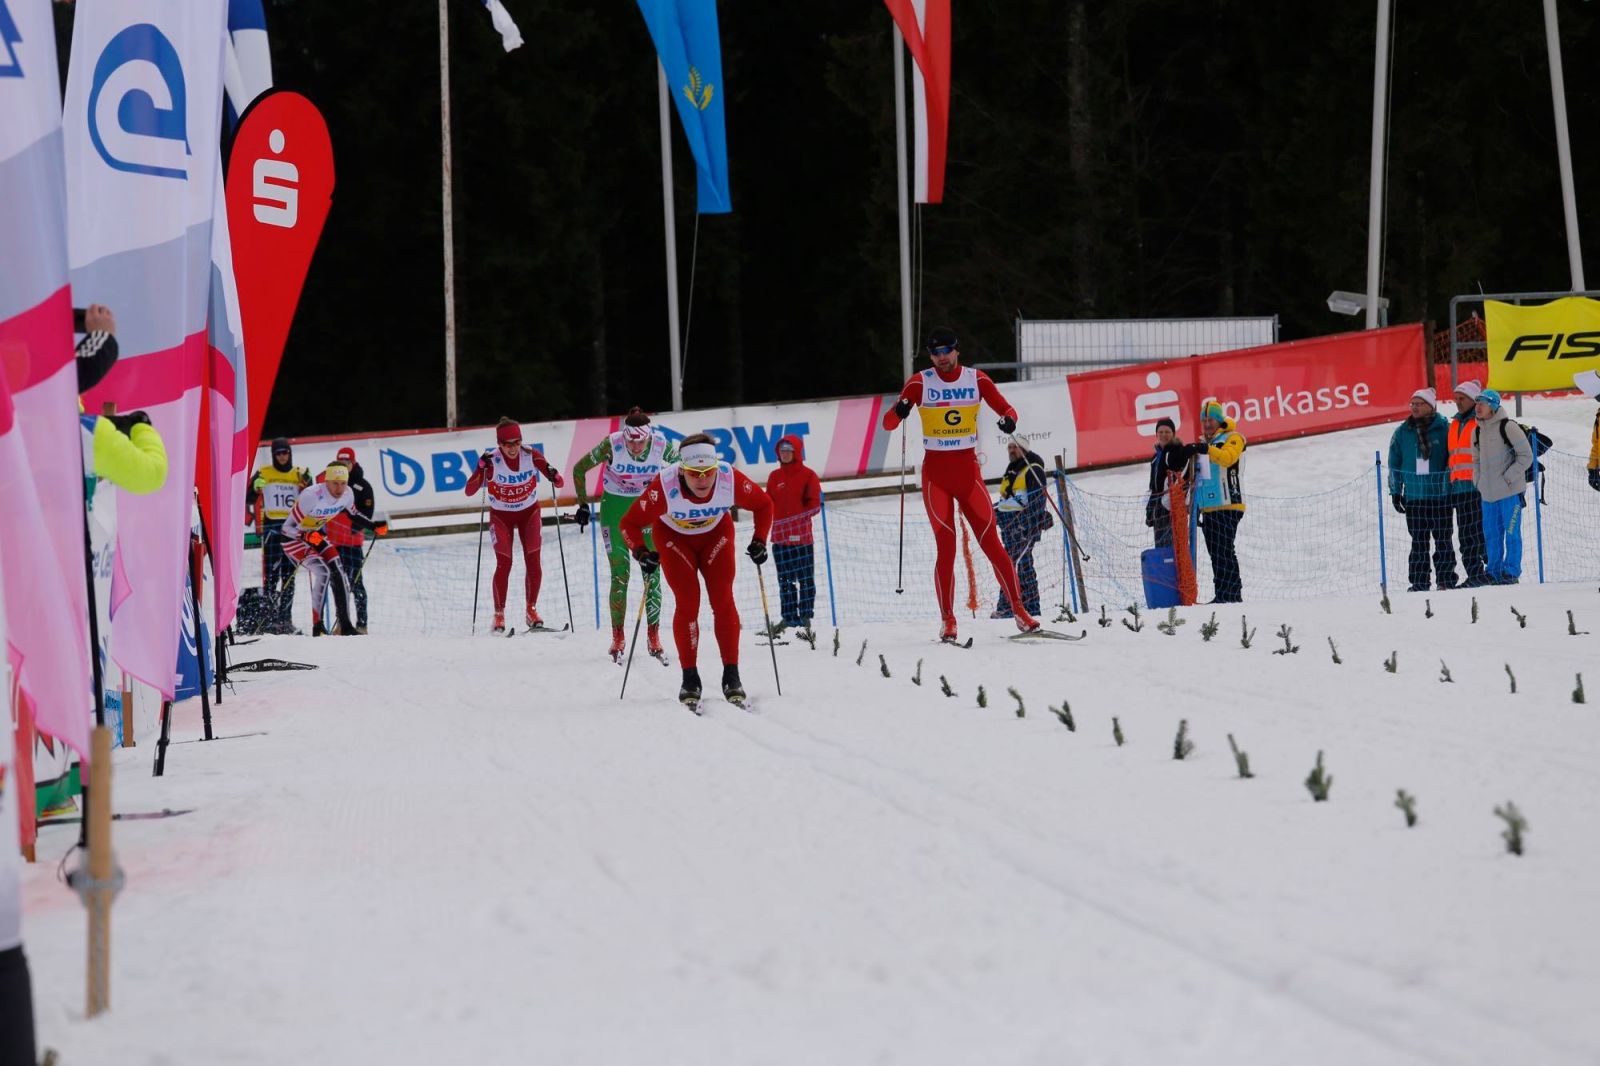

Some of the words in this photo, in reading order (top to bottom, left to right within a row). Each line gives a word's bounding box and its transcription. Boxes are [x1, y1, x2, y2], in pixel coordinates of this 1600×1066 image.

[1503, 331, 1600, 361] FIS
[942, 387, 975, 400] BWT
[944, 409, 962, 426] G
[627, 464, 659, 474] BWT
[508, 470, 534, 483] BWT
[273, 494, 296, 508] 116
